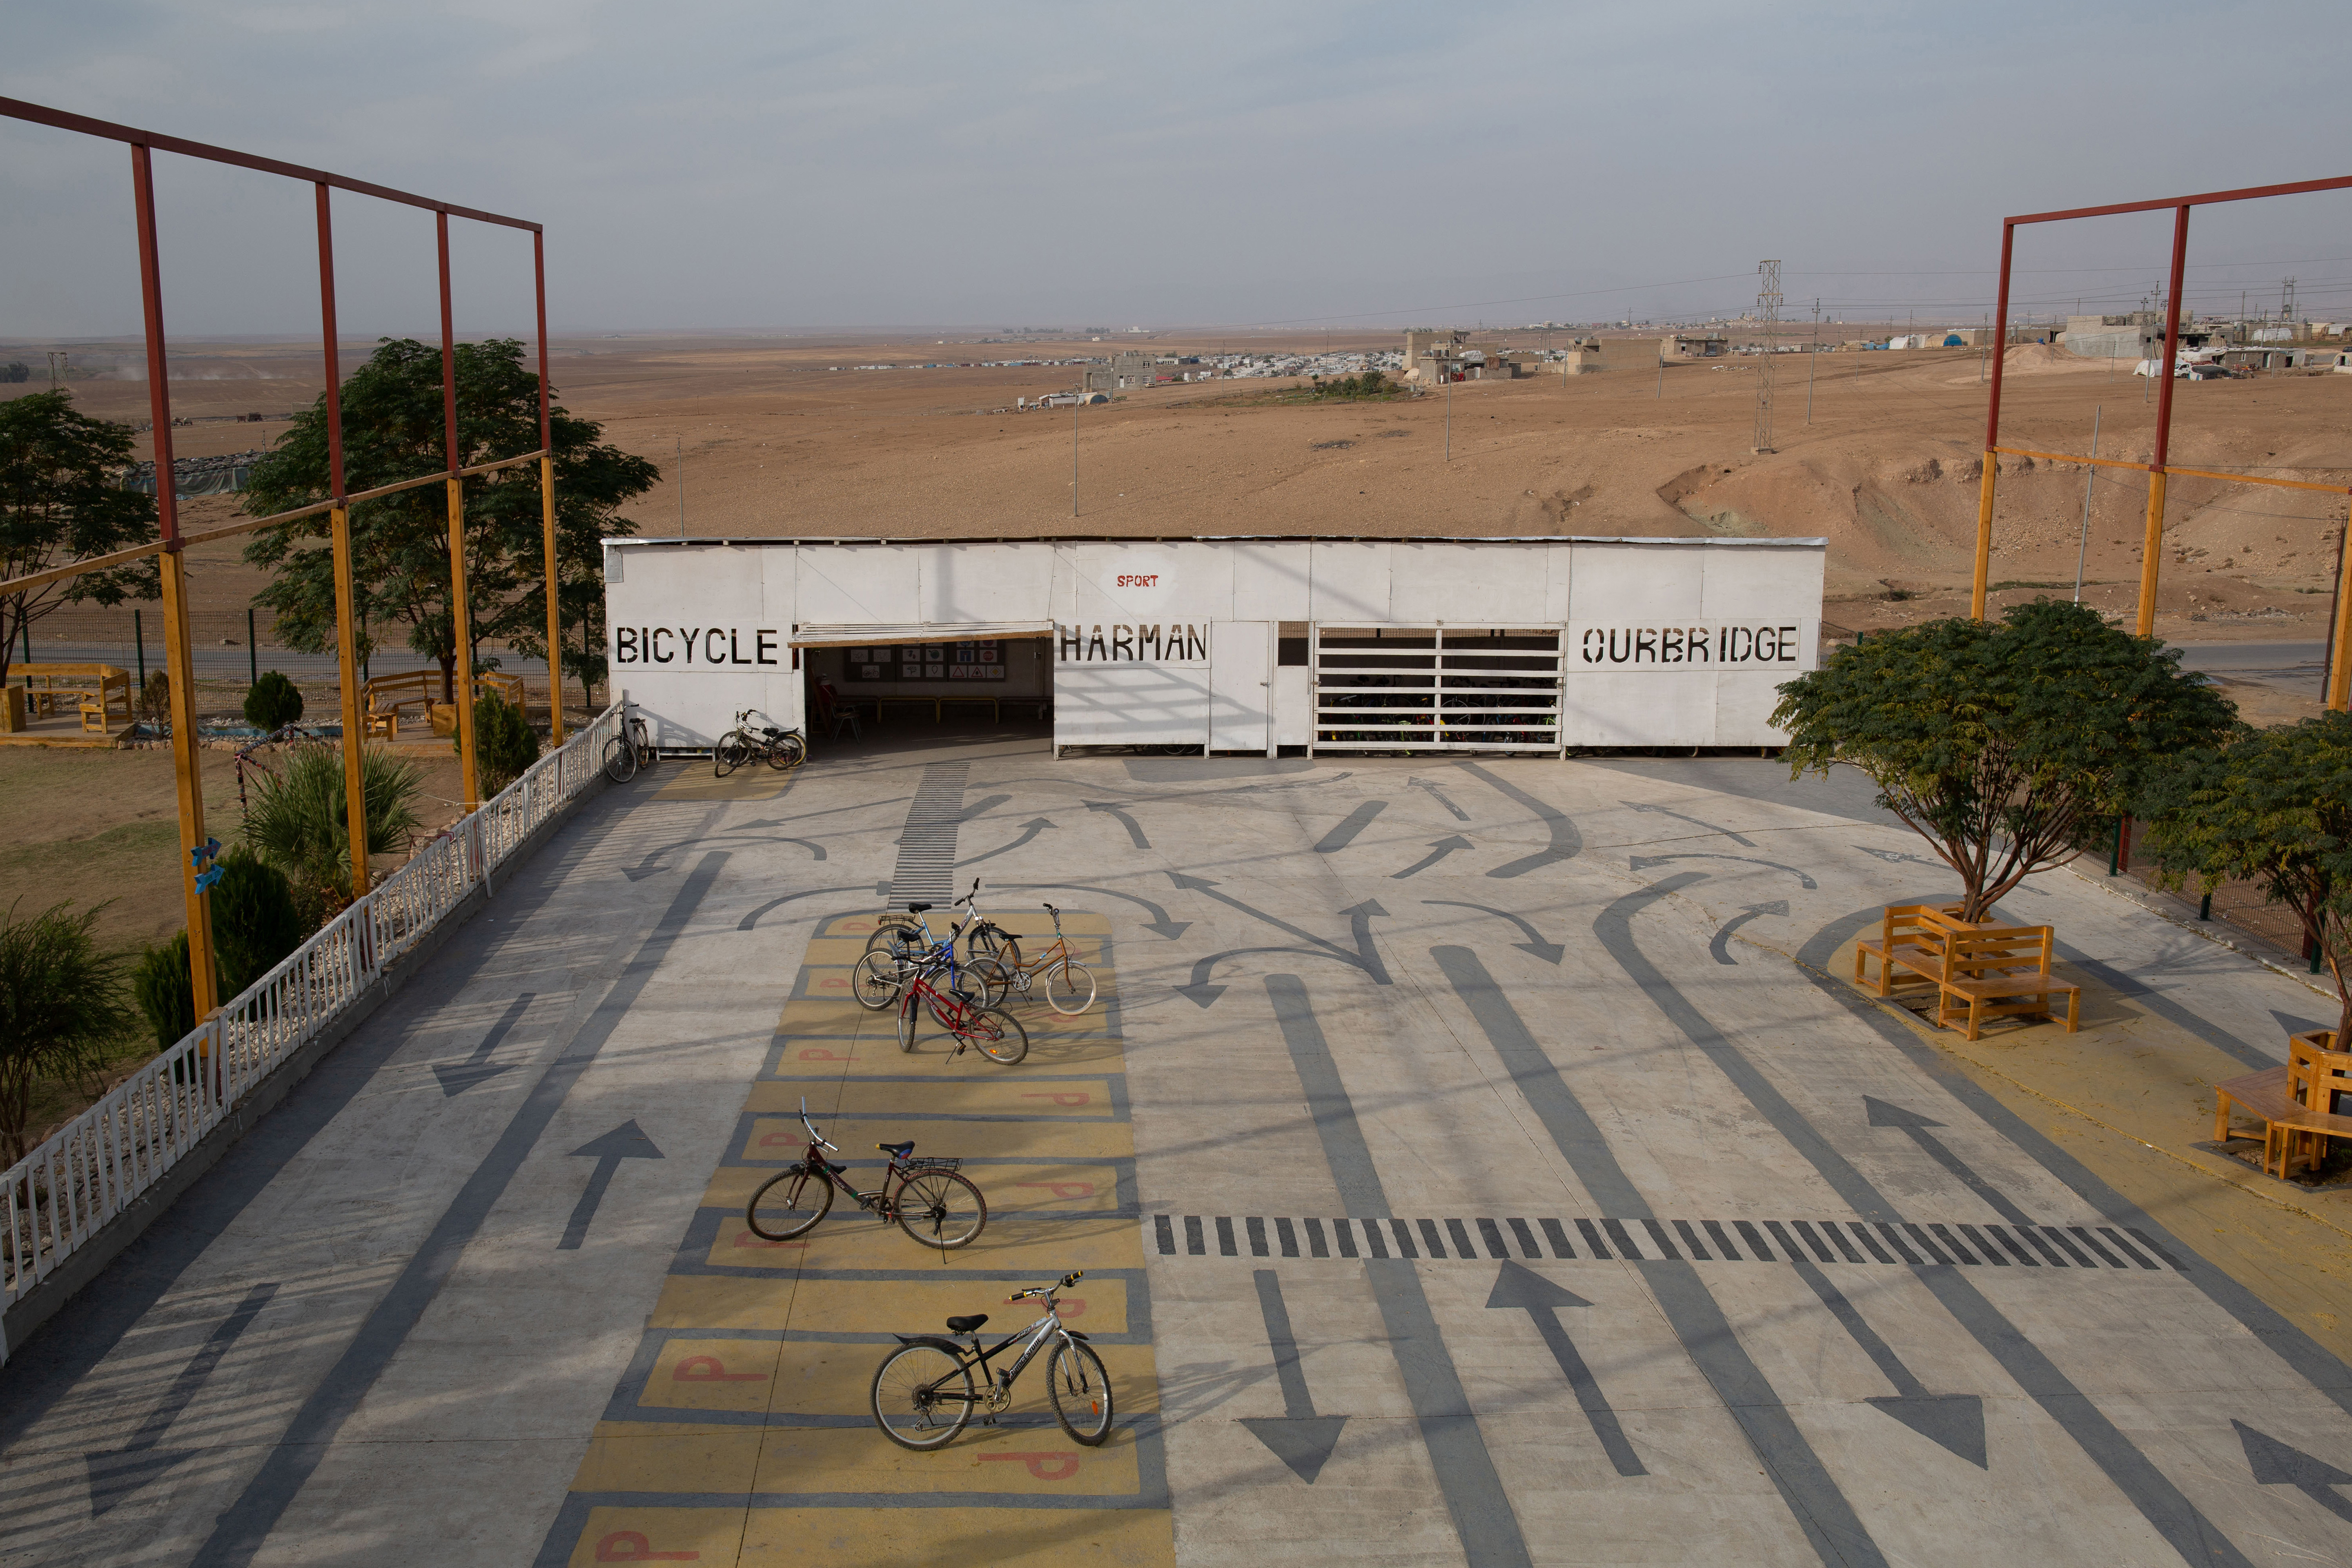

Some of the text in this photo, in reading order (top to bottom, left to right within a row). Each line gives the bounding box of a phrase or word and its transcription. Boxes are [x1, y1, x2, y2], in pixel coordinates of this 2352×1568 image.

[1117, 575, 1158, 587] SPORT
[617, 627, 777, 664] BICYCLE
[1060, 624, 1207, 661] HARMAN
[1583, 626, 1797, 664] OURBRIDGE
[842, 922, 878, 930] P
[819, 978, 872, 988] P
[921, 992, 938, 1011] KREIDLER
[799, 1048, 861, 1061] P
[1021, 1093, 1090, 1107] P
[759, 1132, 834, 1147] P
[1016, 1182, 1095, 1199] P
[1003, 1298, 1087, 1319] P
[673, 1355, 769, 1381] P
[977, 1451, 1079, 1480] P
[595, 1530, 700, 1562] P
